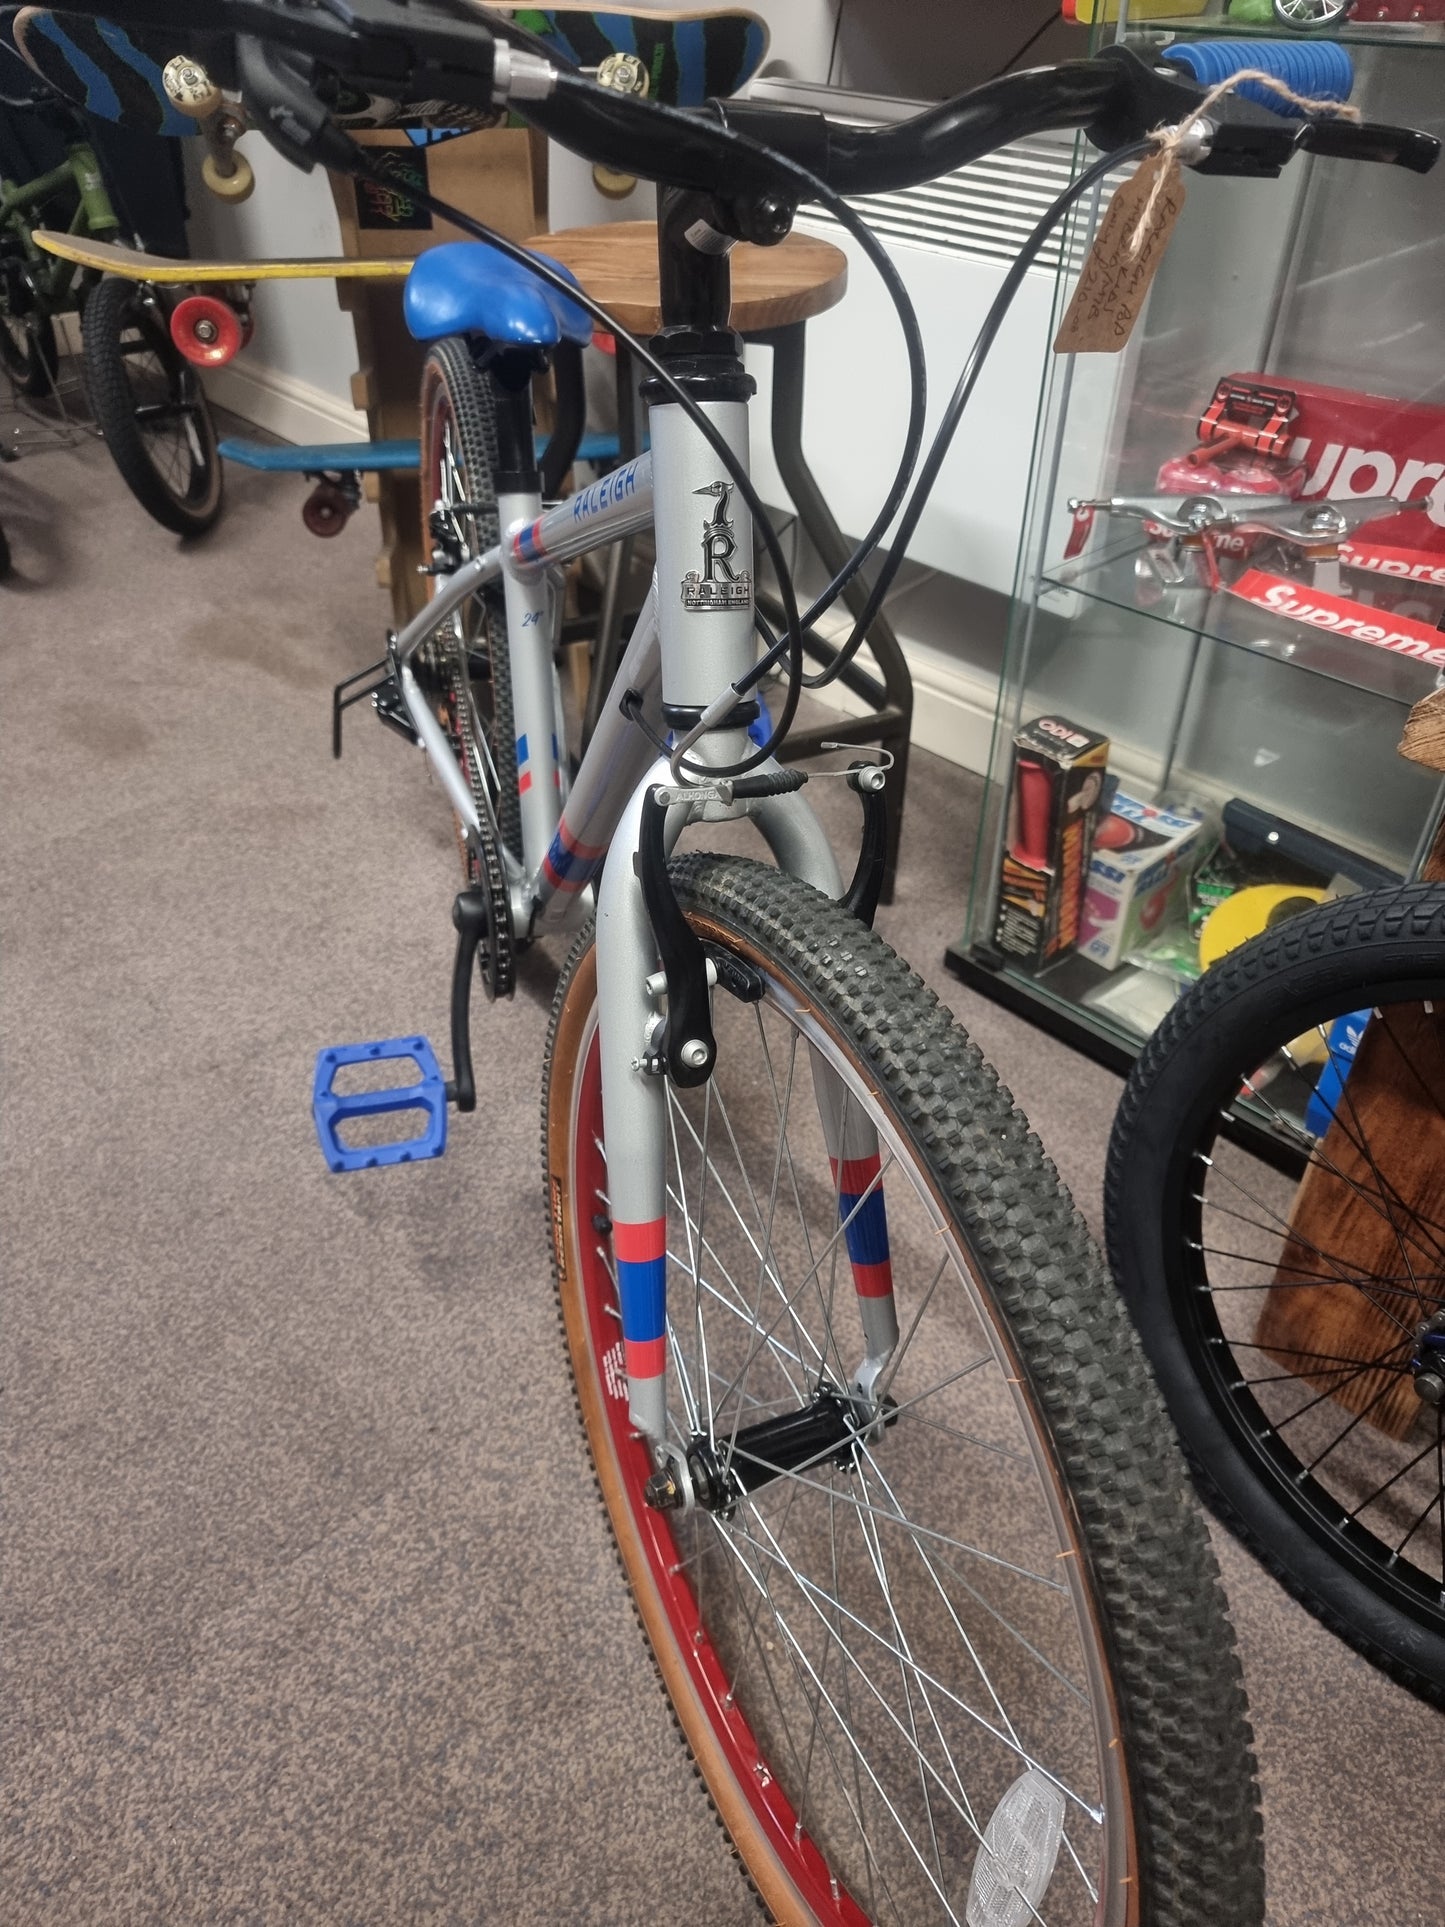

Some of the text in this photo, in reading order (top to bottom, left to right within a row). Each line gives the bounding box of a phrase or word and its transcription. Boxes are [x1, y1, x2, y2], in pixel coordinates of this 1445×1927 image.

[573, 461, 639, 524] RALEIGH
[1289, 437, 1445, 528] upr
[687, 586, 750, 597] RALEIGH
[1250, 584, 1445, 666] Supreme
